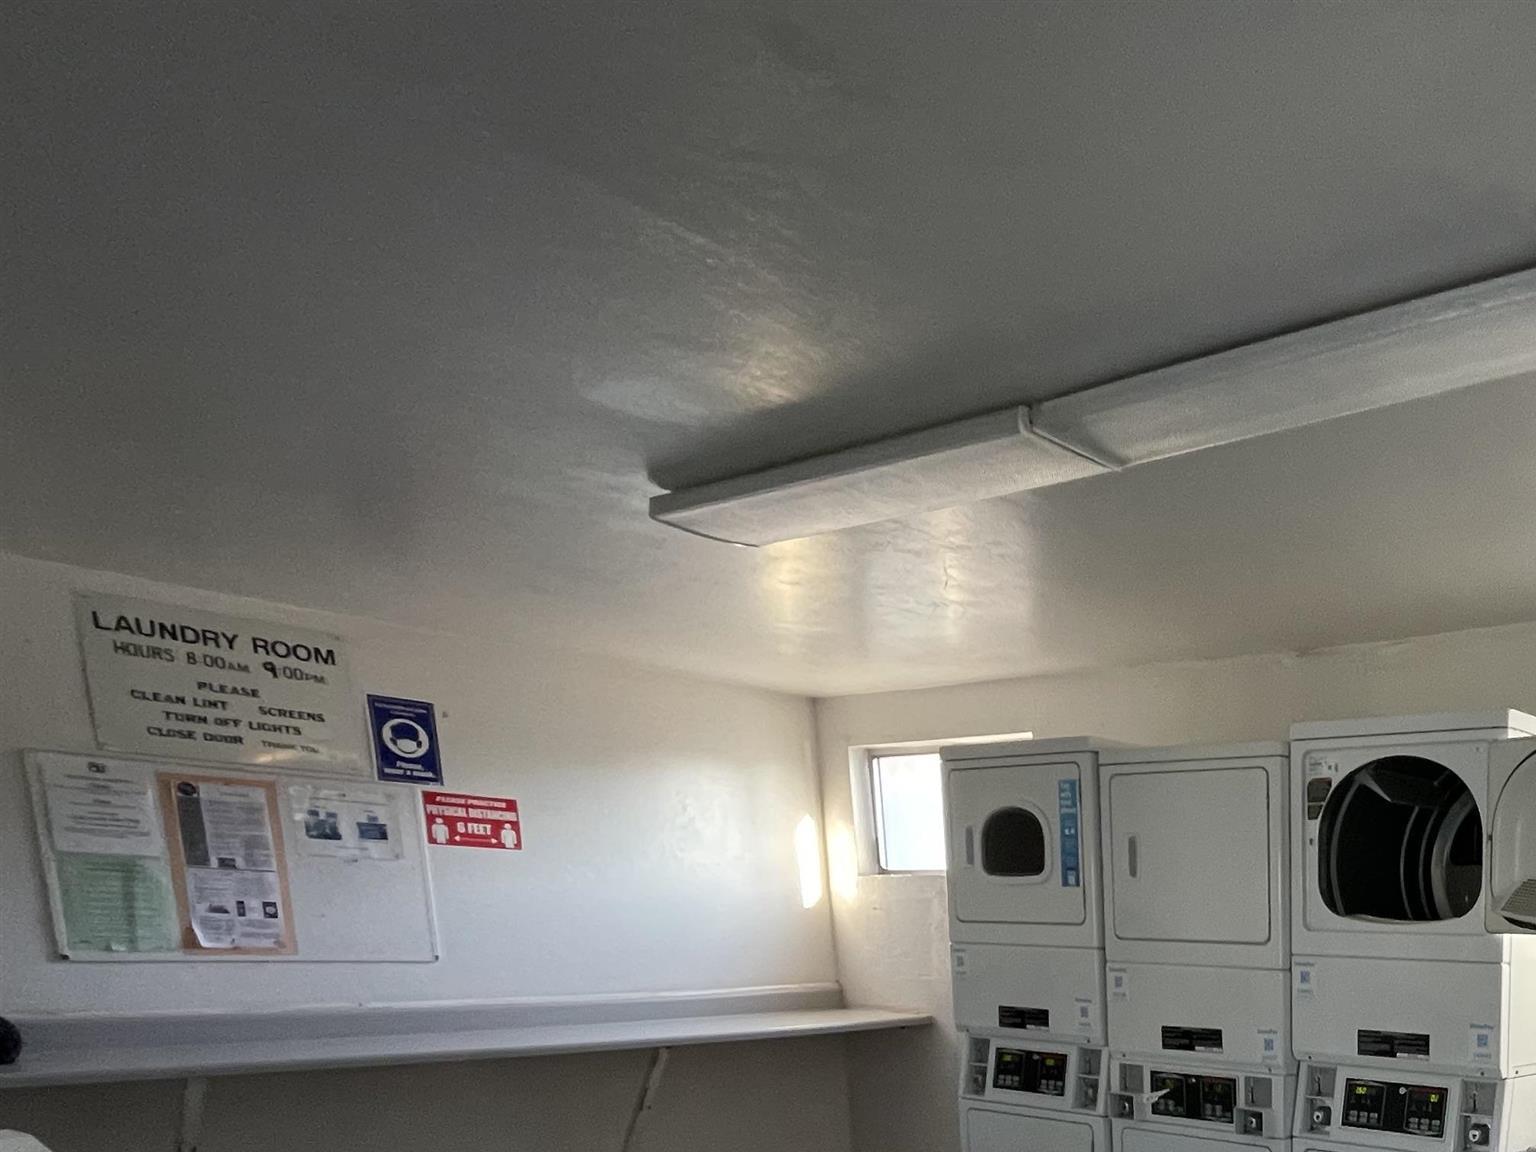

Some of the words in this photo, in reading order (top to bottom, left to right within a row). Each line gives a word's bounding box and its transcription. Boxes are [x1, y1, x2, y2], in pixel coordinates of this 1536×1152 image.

[92, 611, 239, 650] LAUNDRY
[252, 636, 336, 666] ROOM
[113, 640, 175, 662] HOURS
[197, 681, 260, 698] PLEASE
[130, 689, 186, 705] CLEAN
[193, 697, 228, 711] LINT
[258, 705, 326, 723] SCREENS
[162, 711, 208, 725] TURN
[214, 717, 242, 728] OFF
[248, 721, 302, 736] LIGHTS
[147, 726, 197, 741] CLOSE
[203, 732, 244, 745] DOOR
[467, 822, 492, 835] FEET
